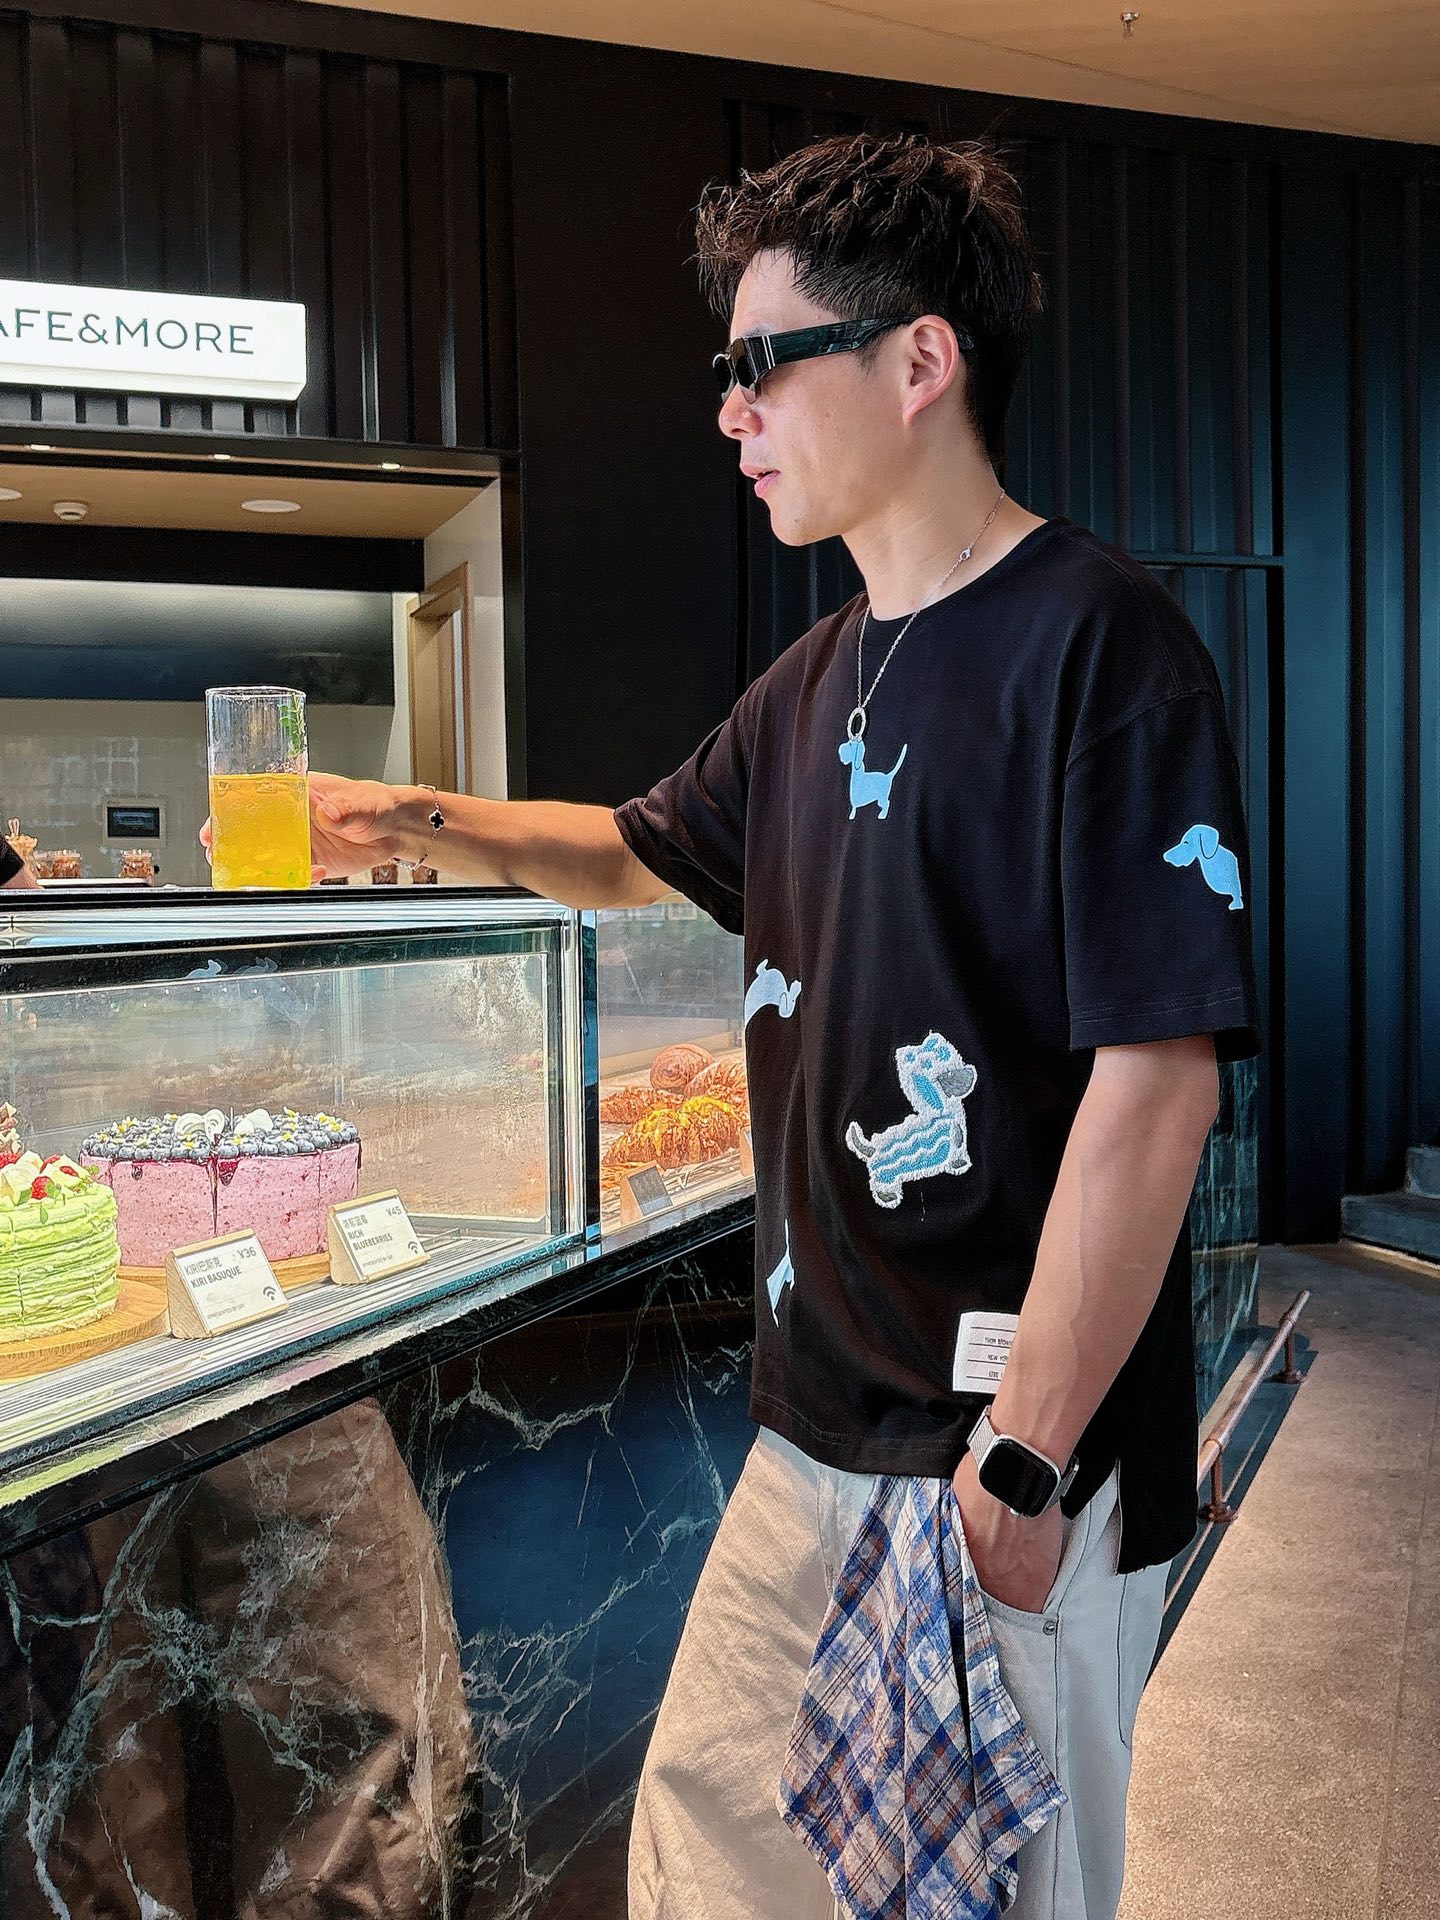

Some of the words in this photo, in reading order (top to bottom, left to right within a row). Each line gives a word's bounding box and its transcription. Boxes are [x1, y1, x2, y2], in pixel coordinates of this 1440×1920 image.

[0, 307, 254, 355] FE&MORE
[348, 1229, 364, 1240] RICH
[352, 1233, 393, 1251] BLUEBERRIES
[190, 1276, 208, 1289] KIRI
[208, 1265, 242, 1283] BASUQUE
